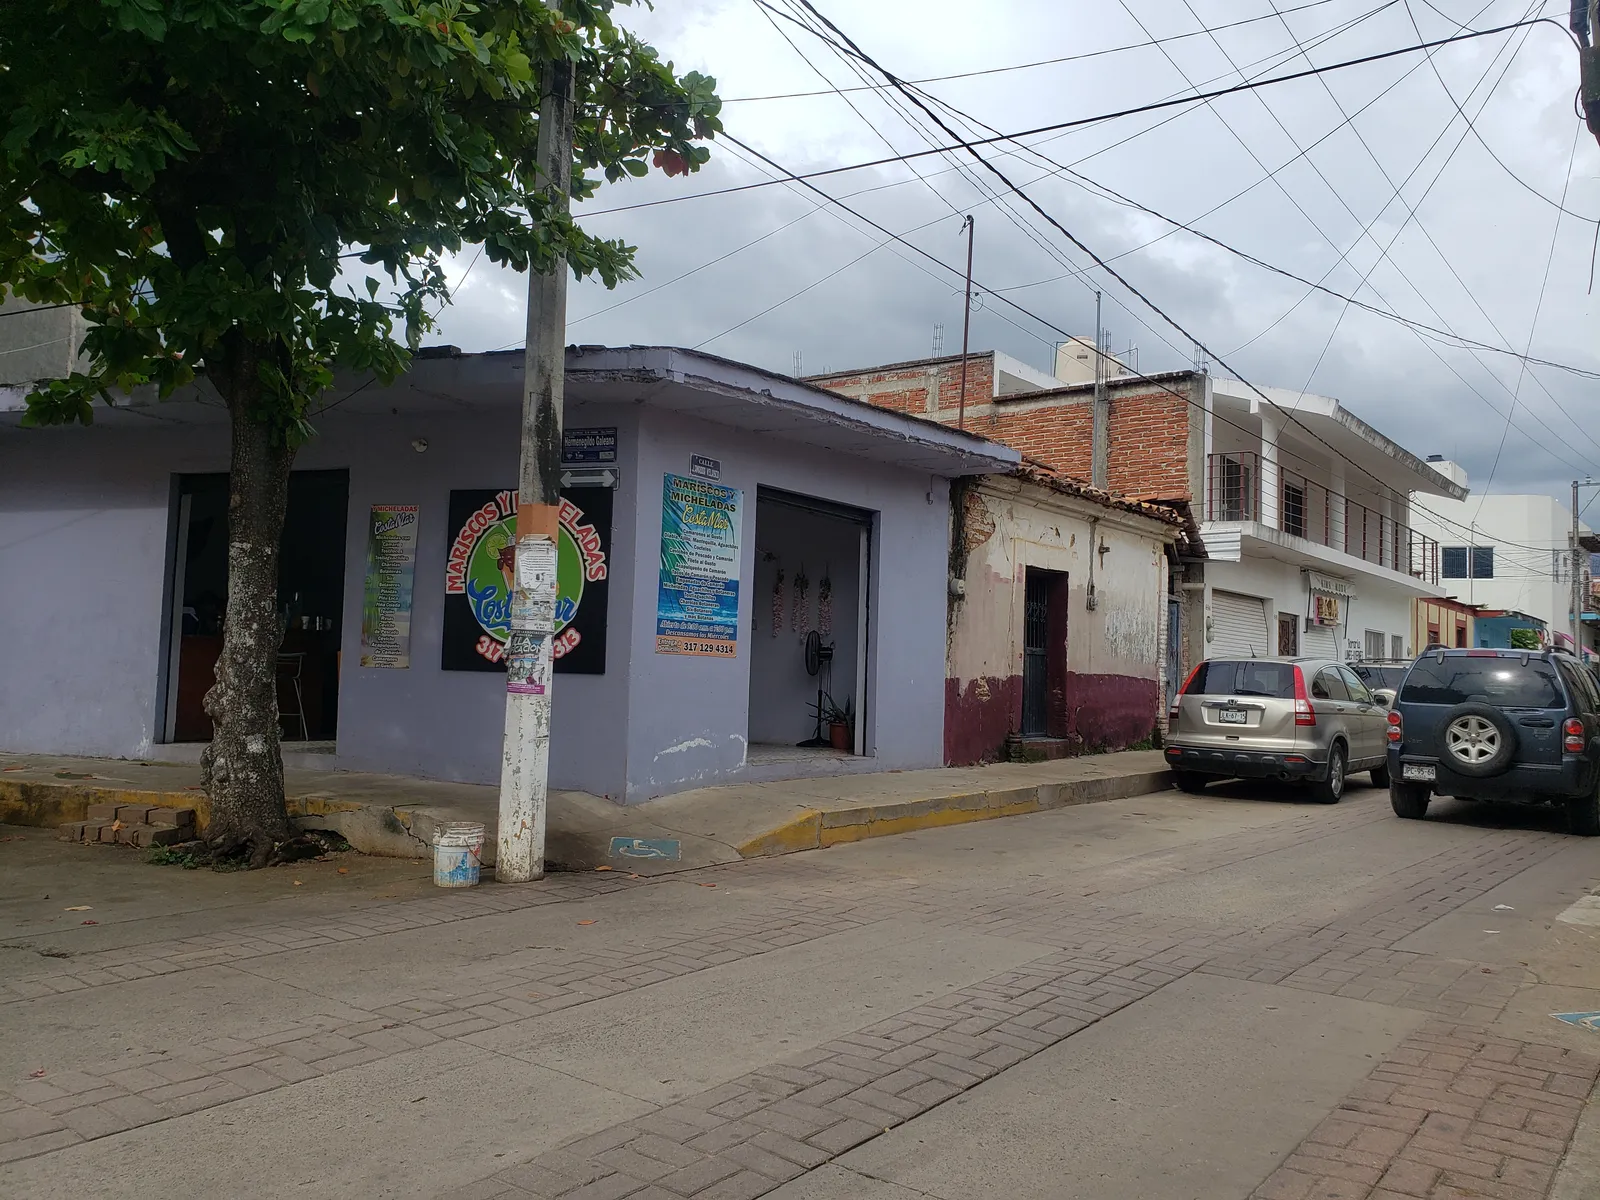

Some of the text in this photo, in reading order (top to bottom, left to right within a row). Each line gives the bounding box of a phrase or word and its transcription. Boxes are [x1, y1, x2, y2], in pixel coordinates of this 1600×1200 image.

[565, 436, 614, 448] Hermenegildo Galeana
[699, 459, 714, 467] CALLE
[674, 478, 726, 498] MARISCOS
[672, 492, 736, 512] MICHELADAS
[682, 504, 729, 529] Costa Mar
[446, 502, 499, 594] MARISCOS
[496, 491, 511, 514] Y
[468, 578, 515, 630] Cost
[476, 635, 504, 663] 317
[684, 642, 733, 654] 317 129 4314
